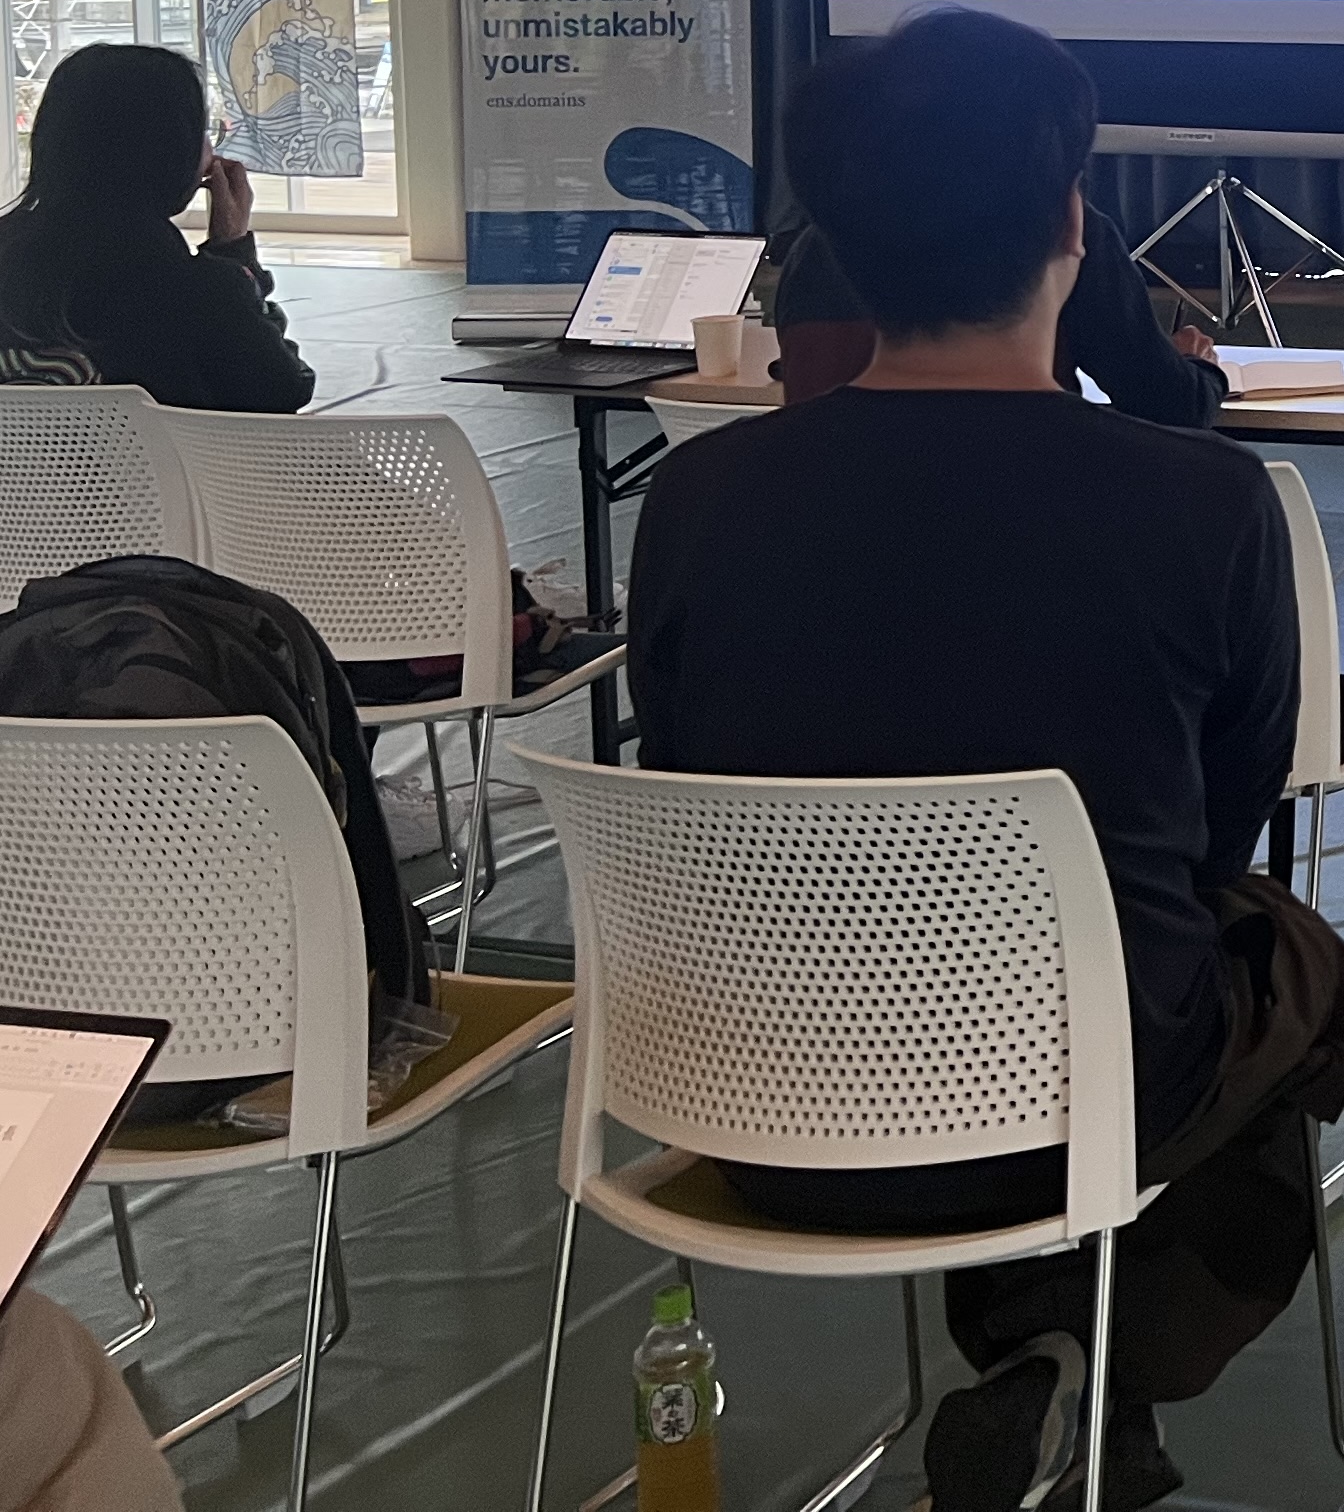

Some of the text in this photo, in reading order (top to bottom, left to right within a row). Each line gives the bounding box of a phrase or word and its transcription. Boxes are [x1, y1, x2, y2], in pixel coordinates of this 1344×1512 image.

[483, 10, 694, 43] unmistakably
[482, 53, 579, 80] yours.
[486, 92, 586, 108] ens.domains
